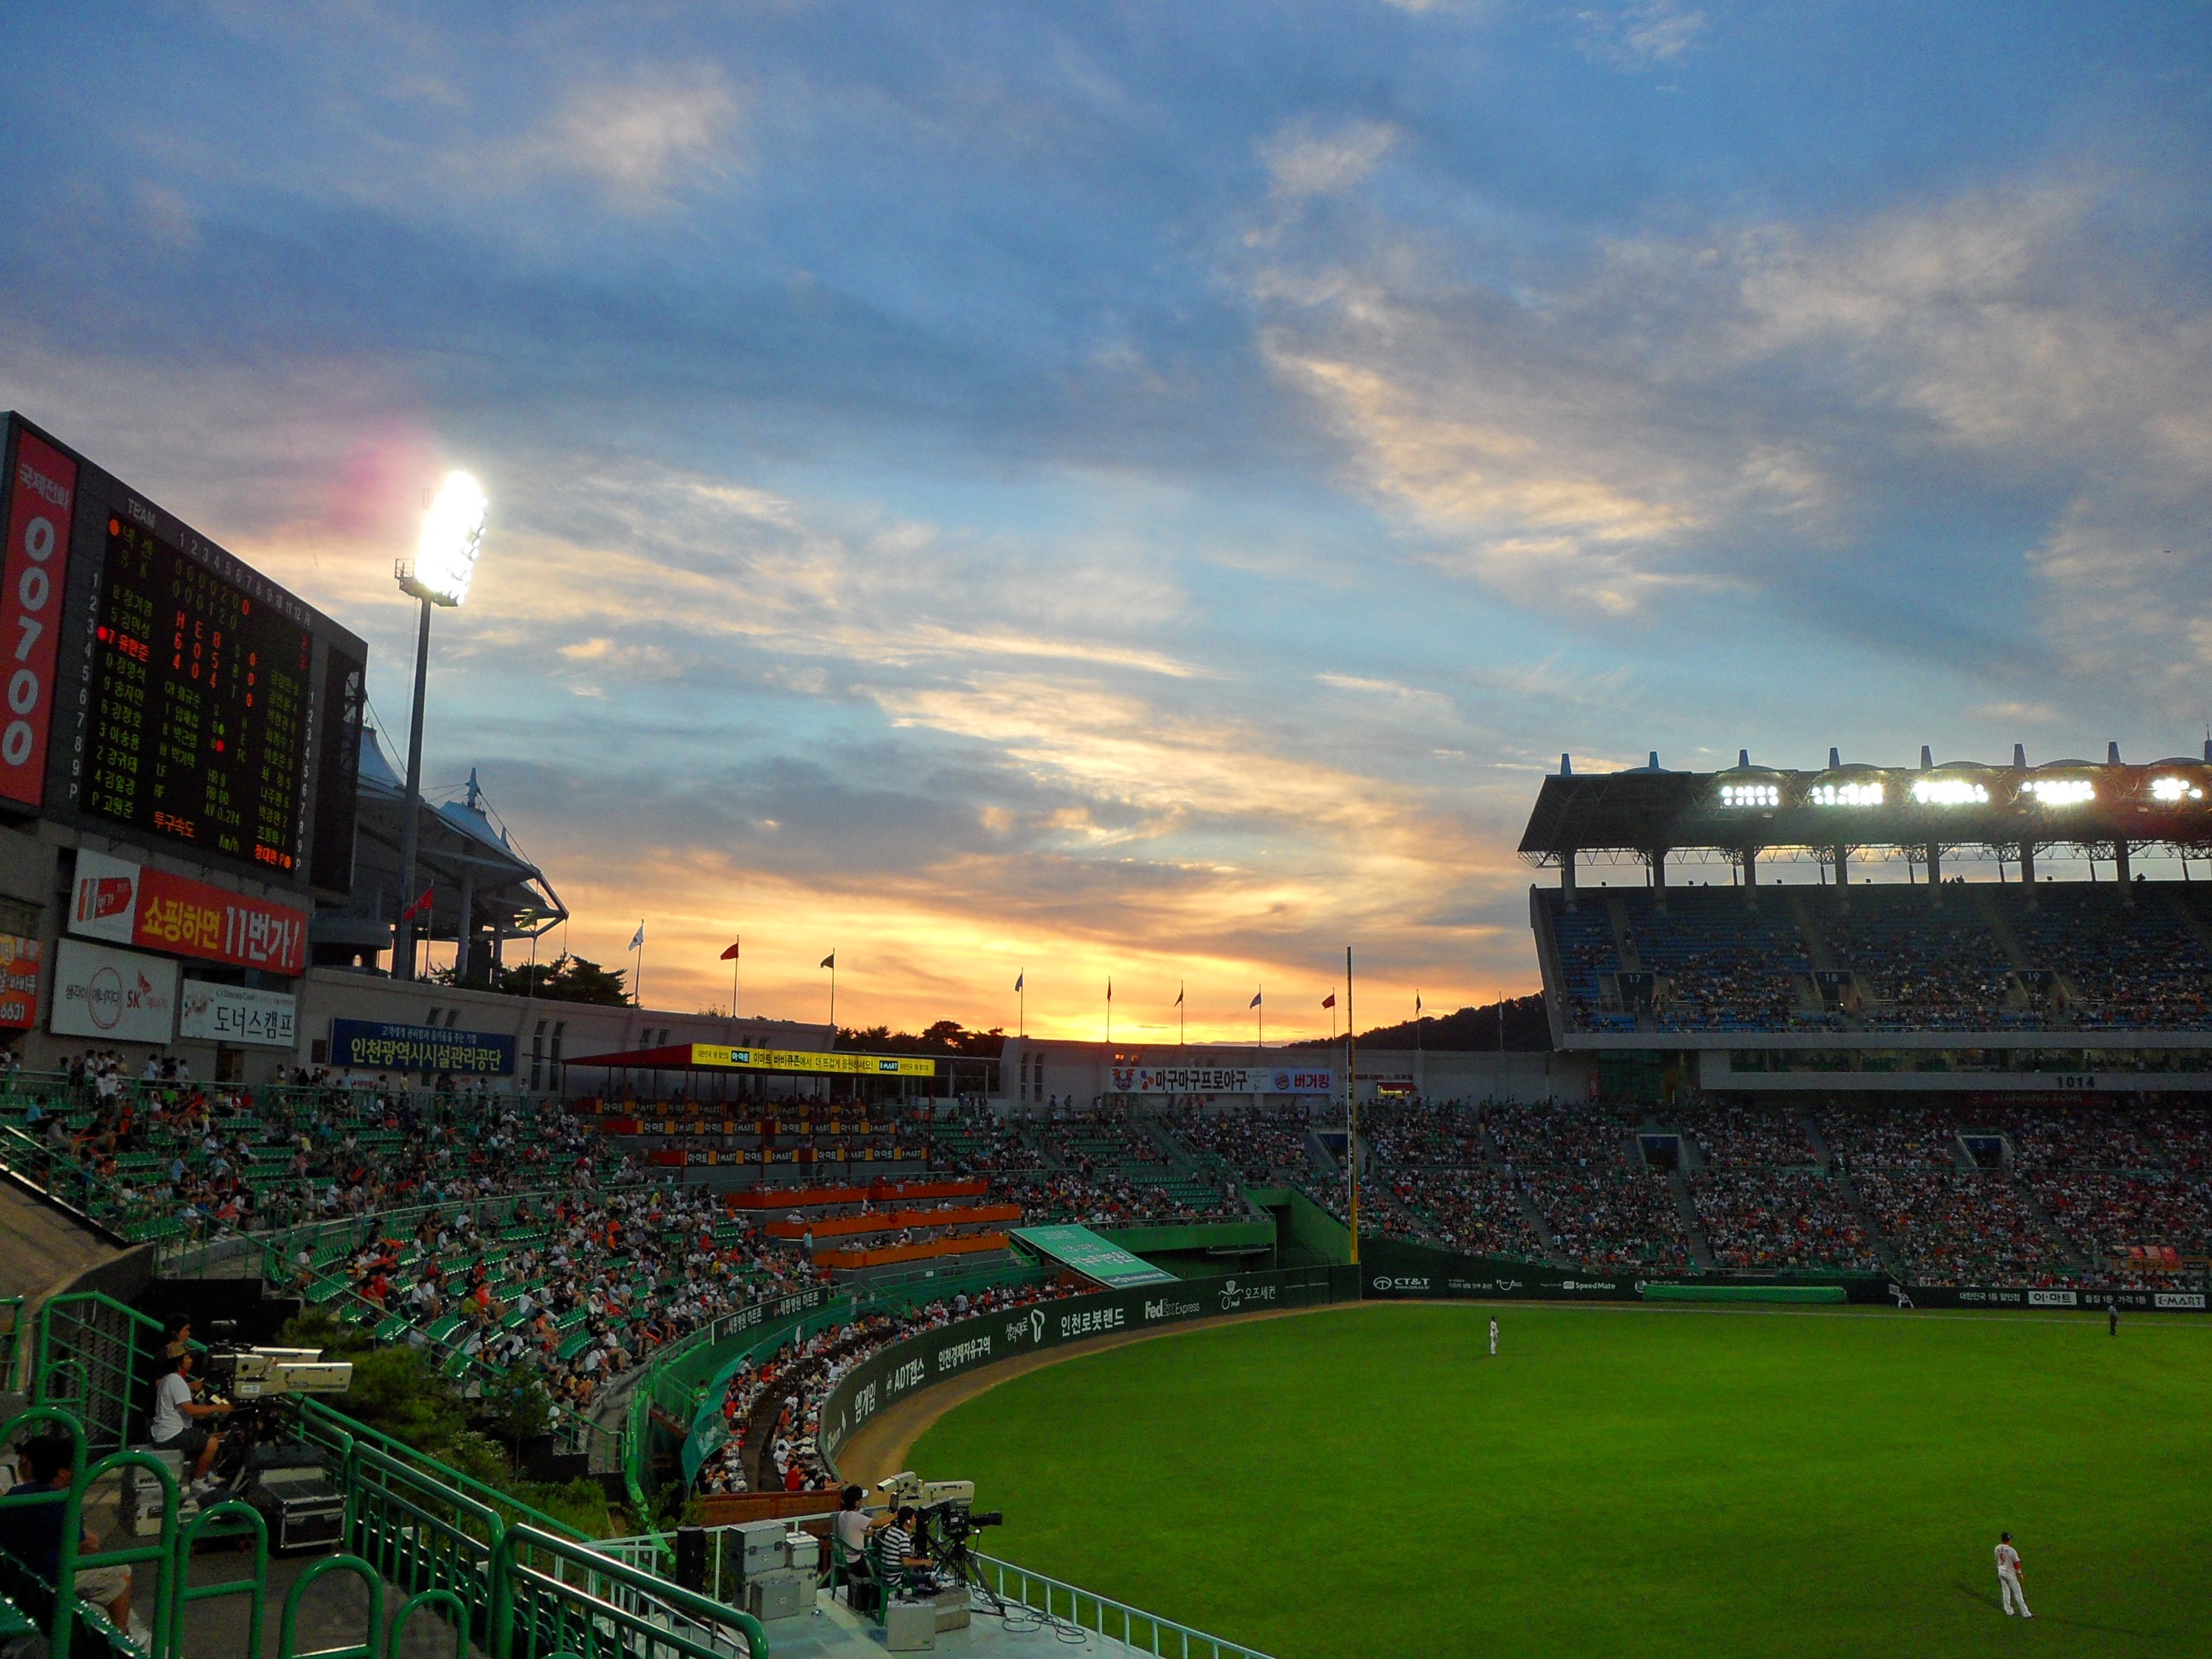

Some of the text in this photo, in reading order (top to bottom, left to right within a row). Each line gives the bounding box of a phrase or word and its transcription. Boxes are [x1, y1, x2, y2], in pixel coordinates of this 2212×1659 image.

[19, 464, 69, 510] 국제전화
[128, 498, 156, 529] TEAM
[92, 573, 98, 588] 1
[180, 532, 185, 547] 1
[191, 539, 197, 556] 2
[202, 547, 208, 562] 3
[214, 555, 220, 570] 4
[225, 561, 231, 576] 5
[236, 568, 242, 583] 6
[247, 575, 253, 590] 7
[256, 581, 262, 596] 8
[266, 588, 272, 602] 9
[276, 595, 283, 608] 10
[286, 601, 292, 613] 11
[294, 606, 302, 621] 12
[88, 595, 97, 612] 2
[242, 598, 250, 616] 0
[87, 618, 94, 635] 3
[176, 609, 203, 639] H E
[84, 641, 91, 658] 4
[174, 631, 219, 669] 6 0 5
[249, 653, 257, 667] 0
[82, 664, 89, 681] 5
[172, 653, 218, 689] 4 0 4
[248, 672, 254, 687] 0
[79, 688, 87, 705] 6
[246, 693, 254, 707] 0
[311, 692, 315, 704] 1
[77, 711, 85, 728] 7
[308, 710, 314, 723] 2
[306, 727, 312, 741] 3
[74, 735, 82, 752] 8
[305, 747, 311, 760] 4
[72, 759, 79, 776] 9
[304, 766, 309, 778] 5
[302, 783, 307, 797] 6
[69, 783, 77, 799] P
[102, 795, 134, 818] 고원준
[300, 802, 305, 815] 7
[153, 811, 195, 838] 투구속도
[299, 820, 304, 834] 8
[219, 833, 239, 852] Km/h
[297, 839, 302, 852] 9
[295, 858, 301, 871] P
[142, 896, 299, 968] 쇼핑하면 11번가!
[127, 989, 140, 1008] SK
[214, 1006, 293, 1039] 도너스캠프
[351, 1038, 502, 1072] 인천광역시시설관리공단
[754, 1053, 771, 1064] 이마트
[815, 1057, 821, 1067] 더
[823, 1058, 840, 1069] 뜨겁게
[842, 1058, 874, 1070] 응원하세요!
[1155, 1069, 1247, 1092] 마구마구프로야구
[1294, 1074, 1330, 1088] 버거킹
[2056, 1076, 2095, 1088] 1014
[1394, 1277, 1430, 1286] CT&T
[1244, 1286, 1276, 1300] 오즈세컨
[1959, 1291, 1986, 1301] 대한민국
[1987, 1292, 1998, 1302] 1등
[1999, 1293, 2021, 1303] 할인점
[2084, 1294, 2101, 1303] 품질
[2102, 1295, 2113, 1304] 1등
[2118, 1295, 2134, 1304] 가격
[2135, 1296, 2146, 1305] 1등
[2158, 1295, 2204, 1307] E-MART
[779, 1295, 801, 1315] 세종병원
[1144, 1298, 1200, 1319] FedEx Express
[728, 1312, 747, 1335] 세종병원
[1005, 1317, 1029, 1343] 생각대로
[1061, 1308, 1125, 1337] 인천로봇랜드
[938, 1335, 991, 1371] 인천경제자유구역
[894, 1357, 924, 1393] ADT캡스
[855, 1379, 876, 1424] 엠게임
